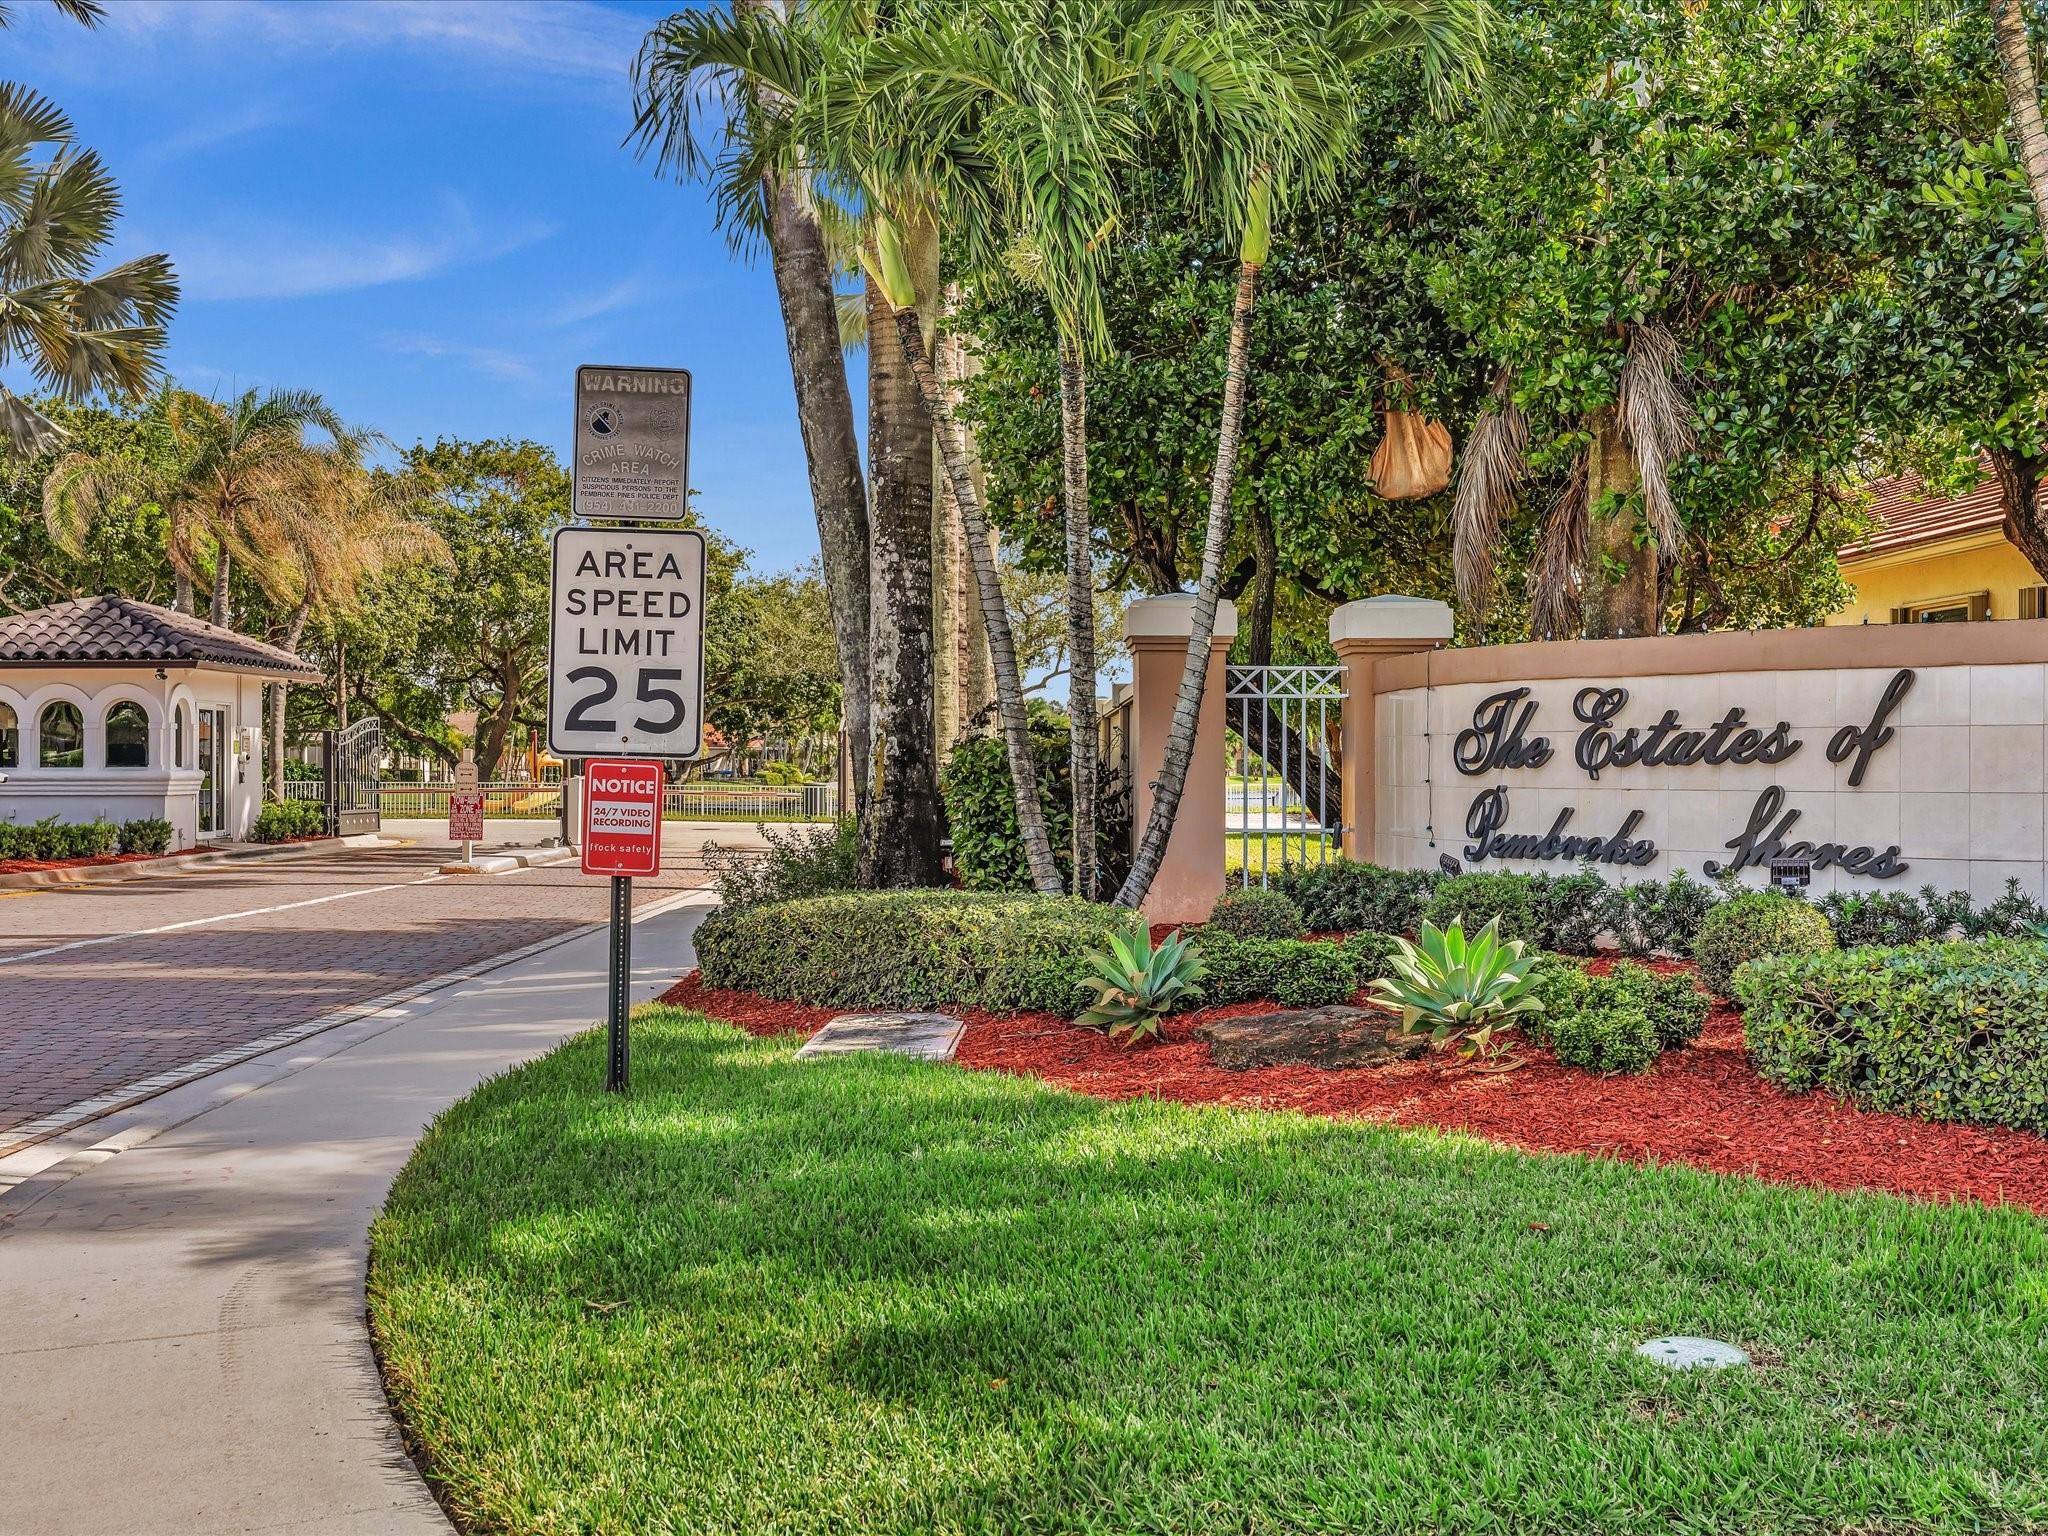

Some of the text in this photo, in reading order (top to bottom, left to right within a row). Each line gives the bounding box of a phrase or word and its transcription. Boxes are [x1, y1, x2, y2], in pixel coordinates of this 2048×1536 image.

[584, 375, 685, 395] WARNING
[583, 444, 680, 470] CRIME WATCH
[611, 462, 650, 475] AREA
[612, 477, 651, 485] IMMEDIATELY
[582, 499, 613, 512] (954)
[575, 550, 682, 579] AREA
[565, 588, 691, 618] SPEED
[578, 627, 675, 656] LIMIT
[564, 665, 686, 734] 25
[1453, 668, 1917, 787] The Estates of
[592, 779, 654, 795] NOTICE
[460, 804, 474, 814] ZONE
[594, 807, 651, 818] 24/7 VIDEO
[594, 818, 650, 828] RECORDING
[1463, 784, 1912, 880] Pembroke Shores
[620, 844, 652, 855] safety
